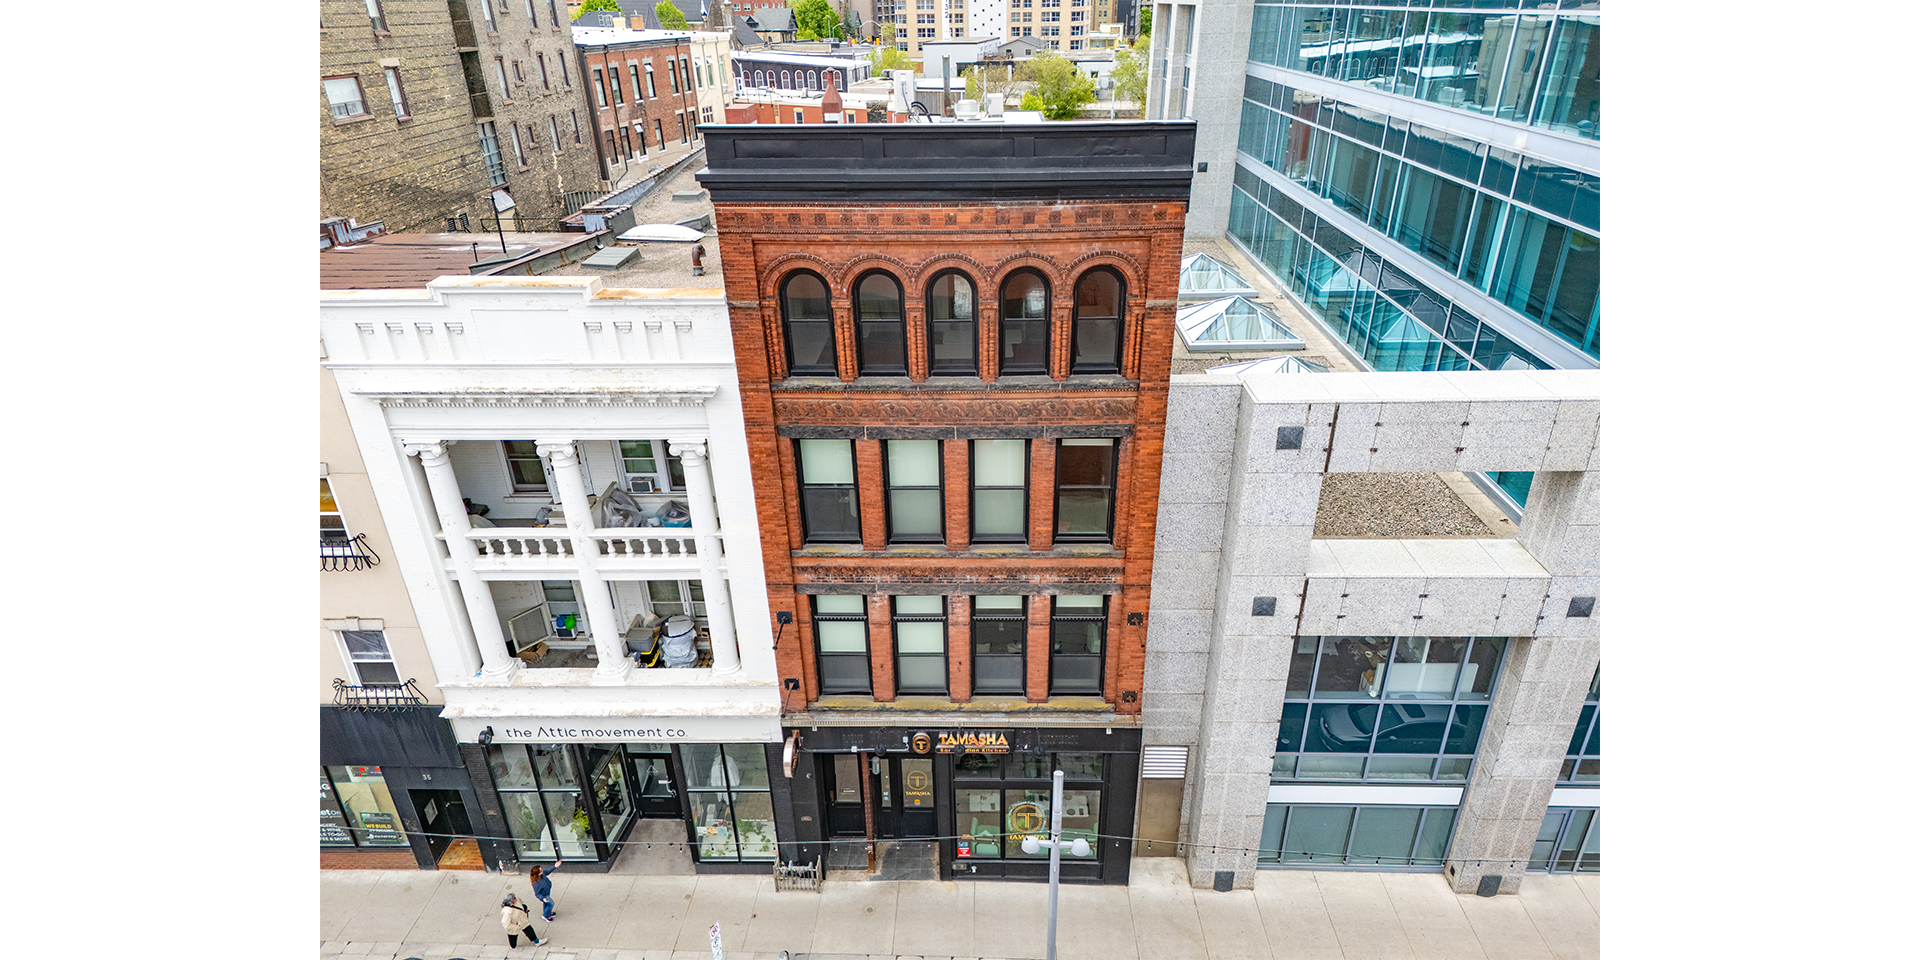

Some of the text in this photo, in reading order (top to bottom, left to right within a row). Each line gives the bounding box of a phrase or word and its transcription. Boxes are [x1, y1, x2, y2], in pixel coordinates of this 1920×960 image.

[505, 726, 689, 738] the Attic movement co.
[938, 733, 1008, 747] TAMASHA
